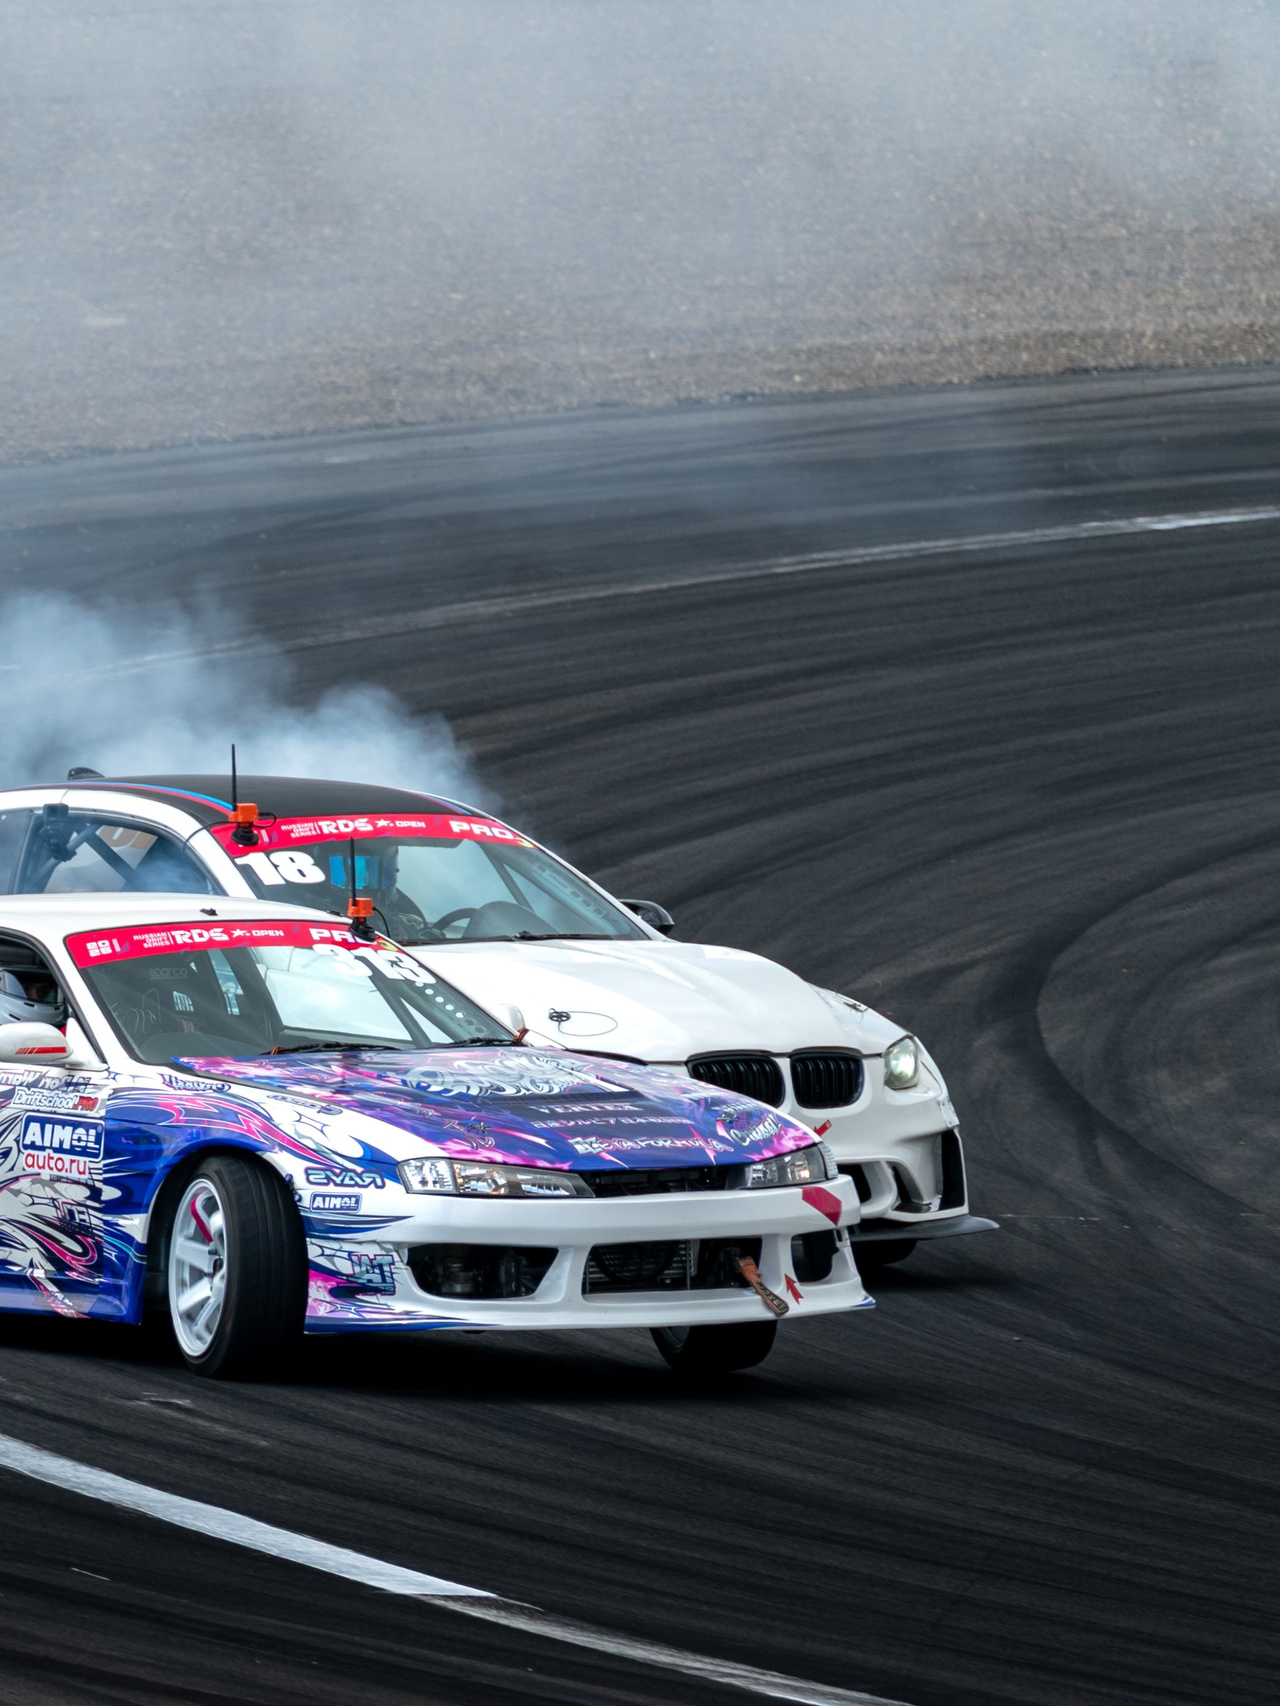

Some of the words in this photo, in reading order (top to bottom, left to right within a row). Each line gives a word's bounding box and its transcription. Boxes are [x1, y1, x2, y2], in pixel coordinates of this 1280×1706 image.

[281, 822, 314, 831] RUSSIAN
[290, 830, 317, 838] SERIES
[319, 818, 374, 834] RDS
[395, 820, 426, 829] OPEN
[449, 820, 516, 840] PRO
[234, 851, 326, 886] 18
[133, 932, 168, 941] RUSSIAN
[145, 936, 168, 944] DRIFT
[171, 928, 230, 945] RDS
[252, 929, 285, 937] OPEN
[309, 928, 377, 945] PR
[143, 940, 170, 949] SERIES
[312, 943, 436, 984] 313
[23, 1122, 100, 1153] AIMOL
[24, 1152, 87, 1175] auto.ru
[312, 1196, 358, 1210] AIMOL
